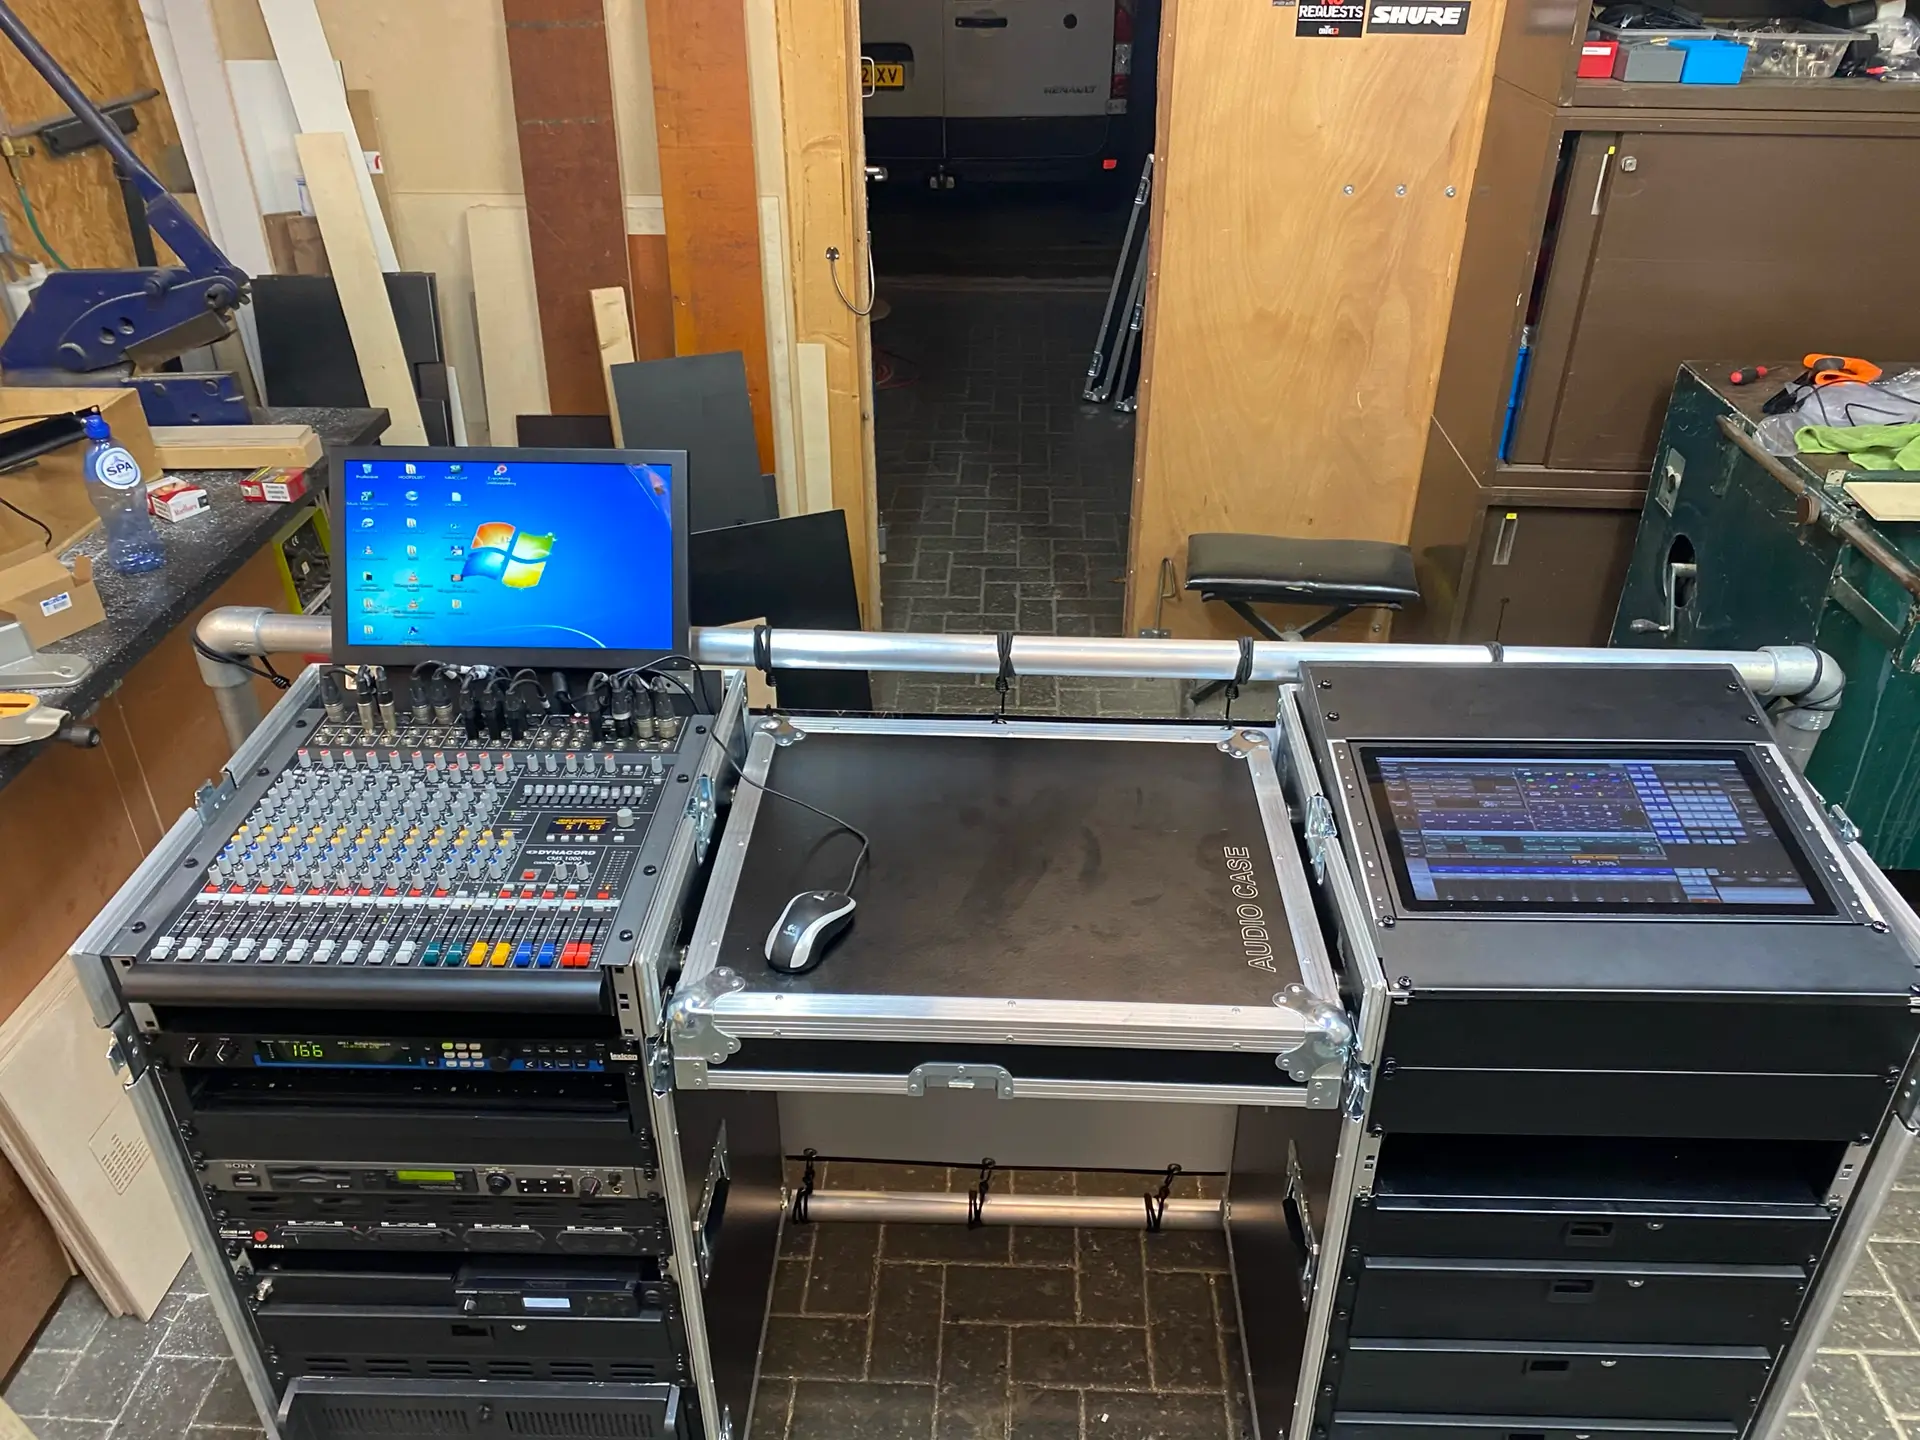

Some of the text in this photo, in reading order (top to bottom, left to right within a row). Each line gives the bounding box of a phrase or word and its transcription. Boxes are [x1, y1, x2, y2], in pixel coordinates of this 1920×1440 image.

[1298, 5, 1364, 18] REQUESTS
[1371, 6, 1461, 27] SHURE
[106, 462, 133, 476] SPA
[1223, 846, 1277, 973] AUDIO CASE
[293, 1044, 323, 1058] 166
